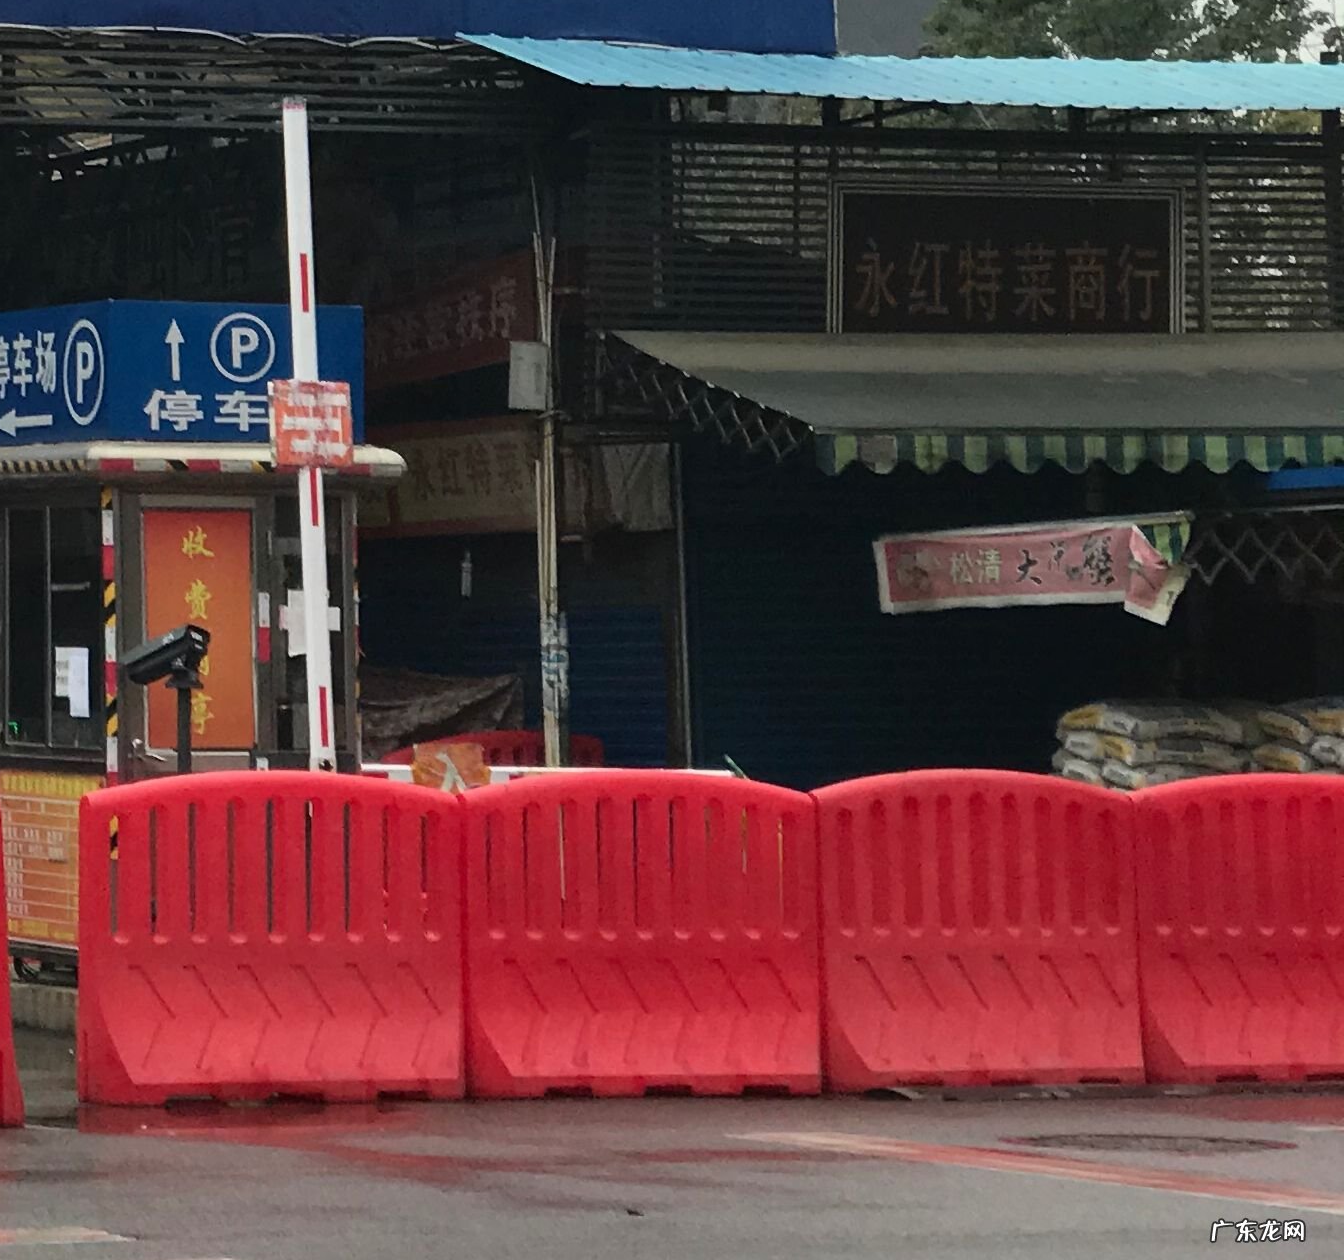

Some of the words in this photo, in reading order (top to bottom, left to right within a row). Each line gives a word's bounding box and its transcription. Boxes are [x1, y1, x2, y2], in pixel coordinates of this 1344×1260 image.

[855, 238, 1161, 322] 永红特菜商行
